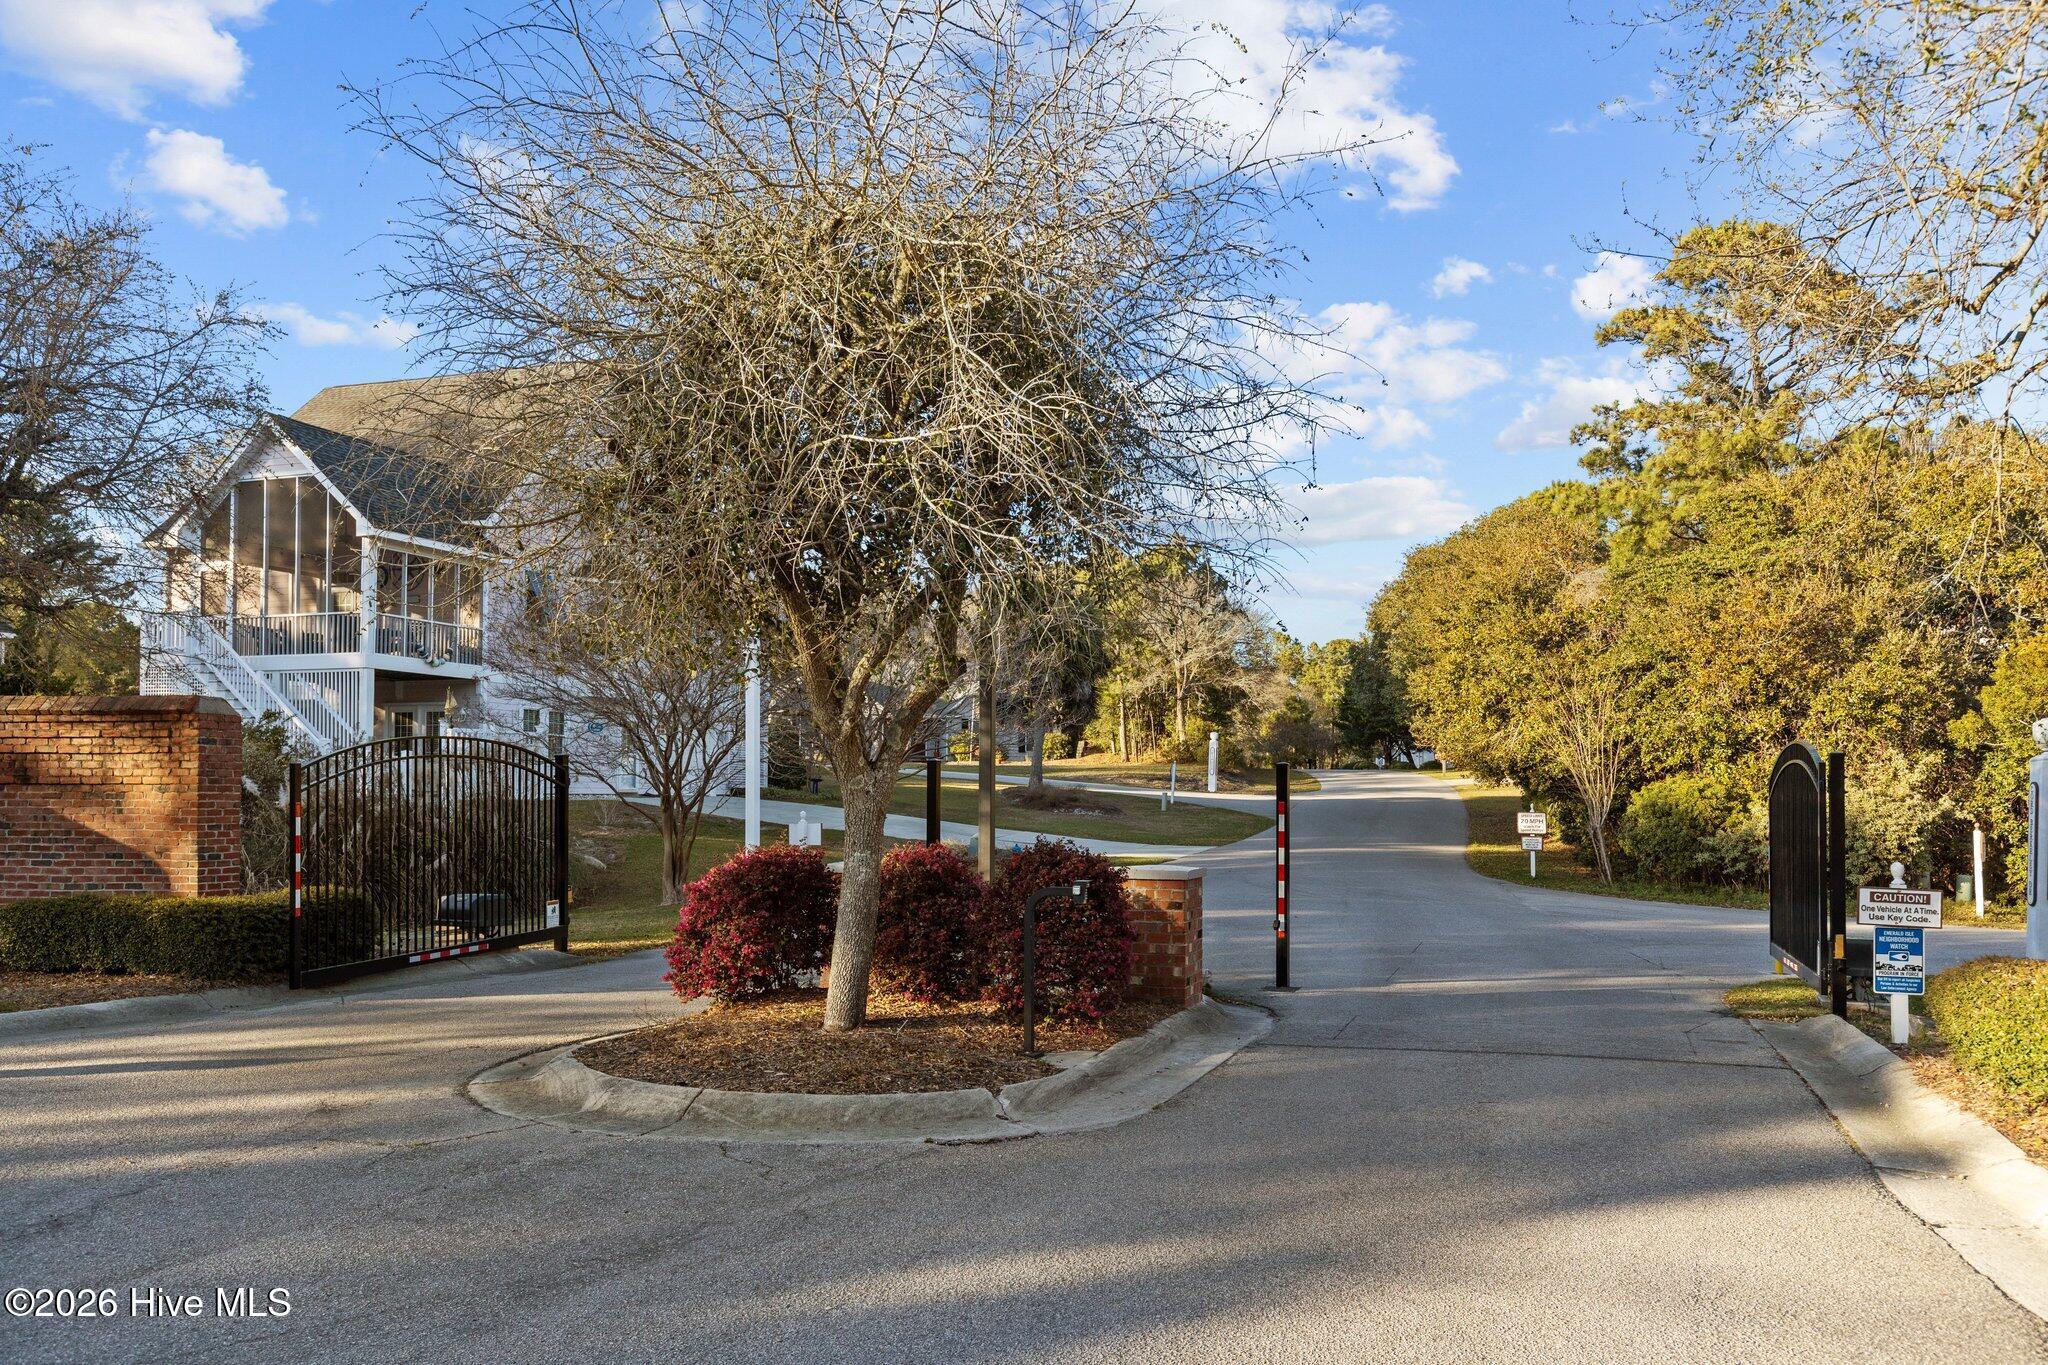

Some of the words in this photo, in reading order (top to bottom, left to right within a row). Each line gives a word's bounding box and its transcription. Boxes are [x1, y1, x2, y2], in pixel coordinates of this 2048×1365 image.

[1874, 893, 1927, 903] CAUTION!
[1920, 908, 1940, 916] Time.
[1888, 914, 1904, 922] Key
